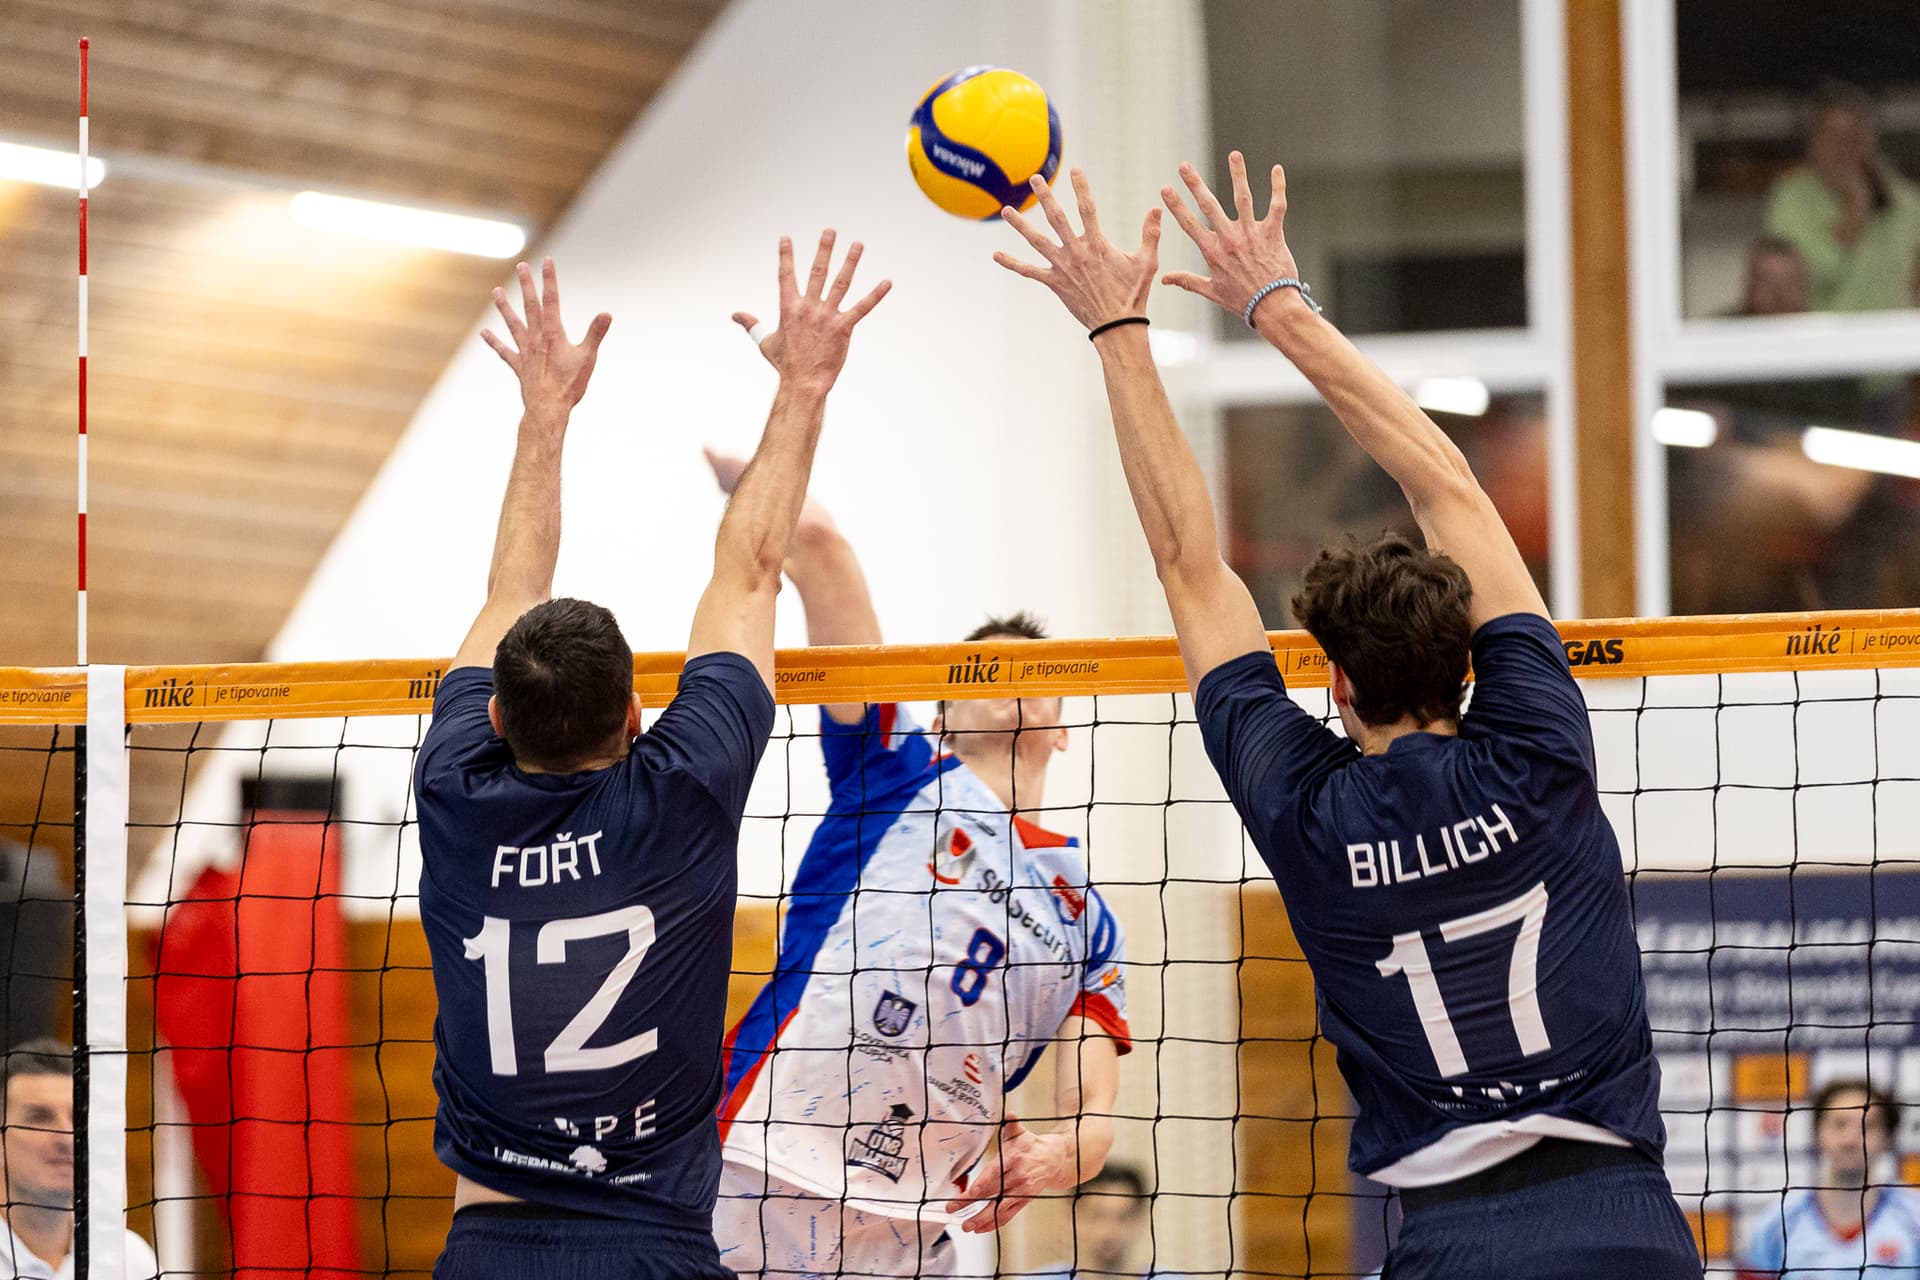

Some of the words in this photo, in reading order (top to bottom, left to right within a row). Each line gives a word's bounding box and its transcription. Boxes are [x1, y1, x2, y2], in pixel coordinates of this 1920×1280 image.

[1563, 639, 1624, 666] GAS
[1786, 625, 1841, 656] niké
[1862, 632, 1876, 650] je
[948, 655, 999, 684] niké
[1020, 661, 1034, 679] je
[1036, 660, 1100, 676] tipovanie
[1296, 652, 1310, 670] je
[11, 688, 72, 705] tipovanie
[145, 678, 194, 708] niké
[215, 686, 229, 703] je
[230, 684, 290, 701] tipovanie
[491, 830, 603, 888] FOŘT
[1347, 803, 1519, 888] BILLICH
[951, 927, 1006, 1007] 8
[1375, 880, 1551, 1078] 17
[462, 904, 658, 1076] 12
